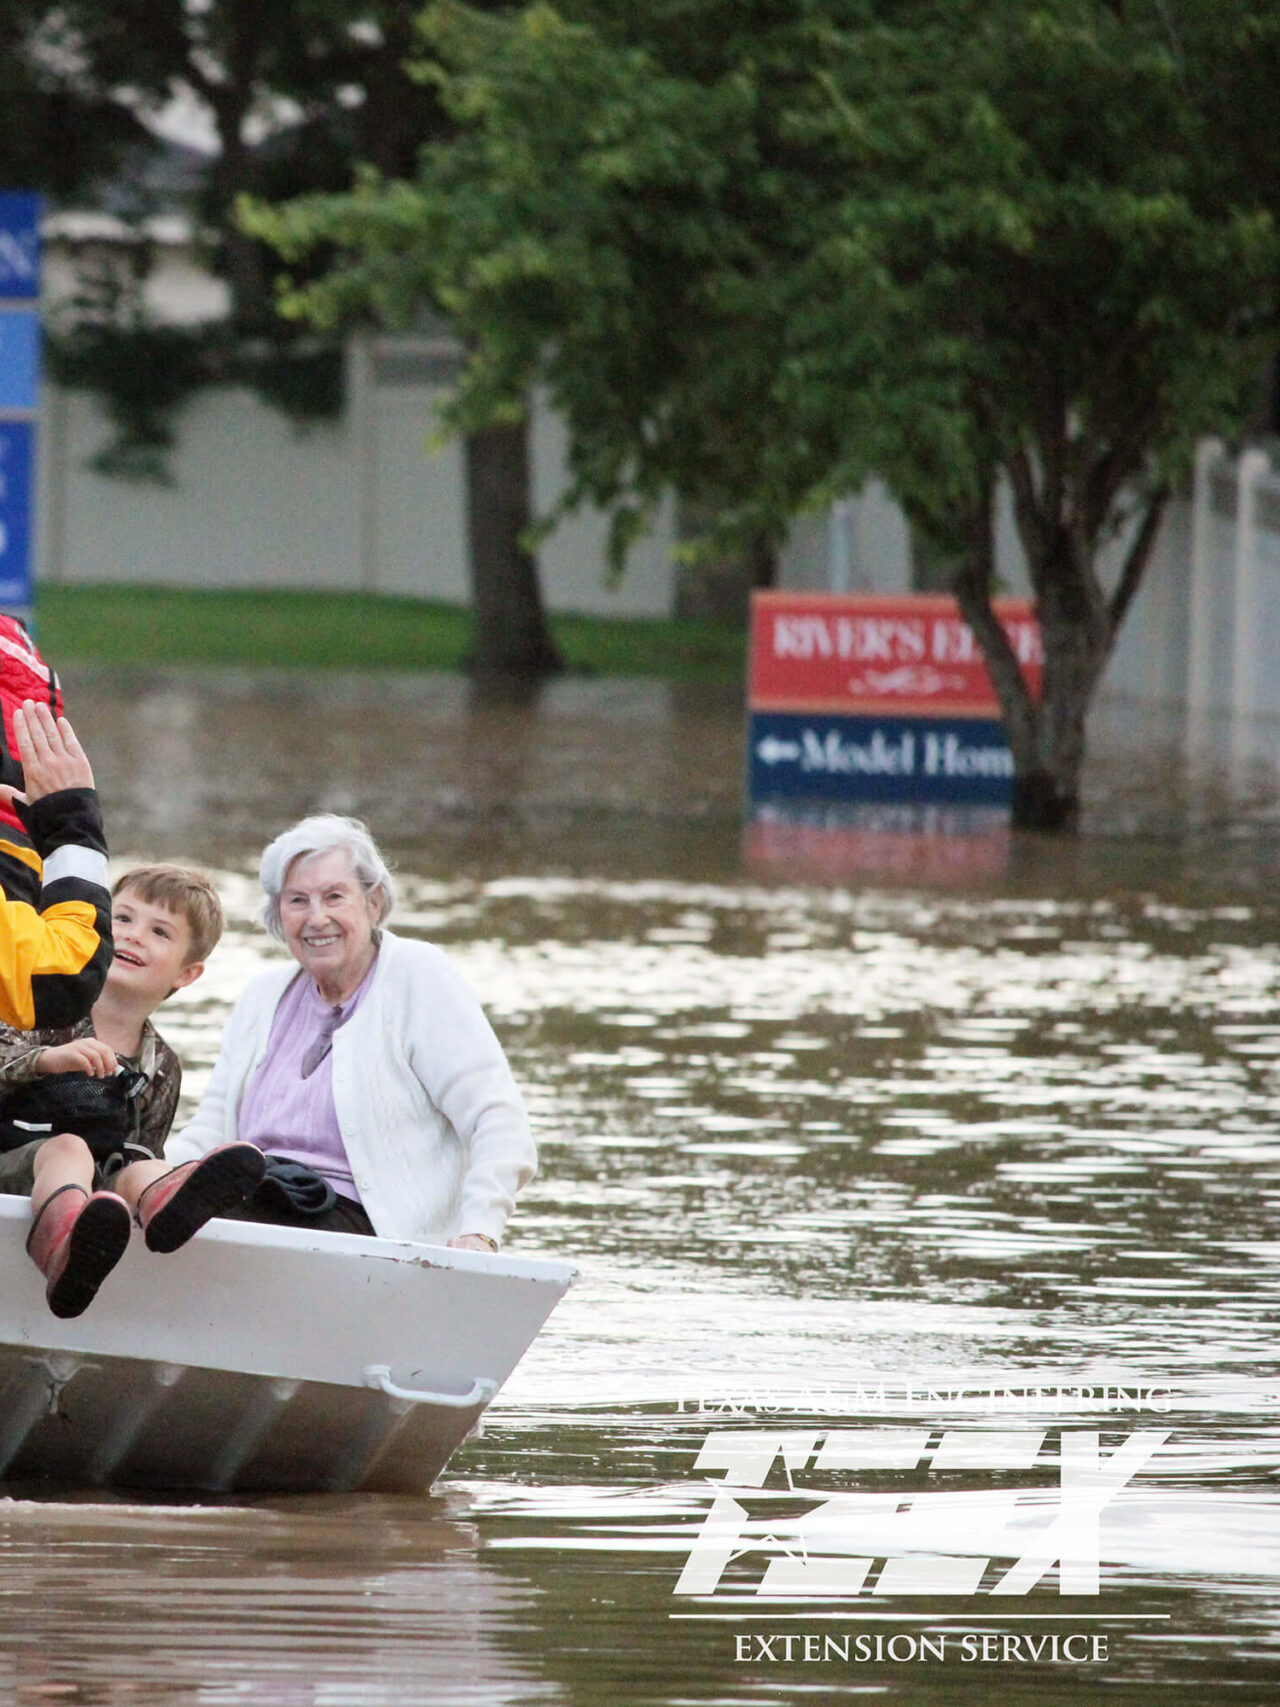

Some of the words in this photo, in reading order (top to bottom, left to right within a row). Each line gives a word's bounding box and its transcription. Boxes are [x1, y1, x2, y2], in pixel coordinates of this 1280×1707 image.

[774, 615, 926, 659] RIVER'S
[932, 618, 1044, 664] EDE
[801, 730, 915, 775] Model
[924, 732, 1014, 777] Hom
